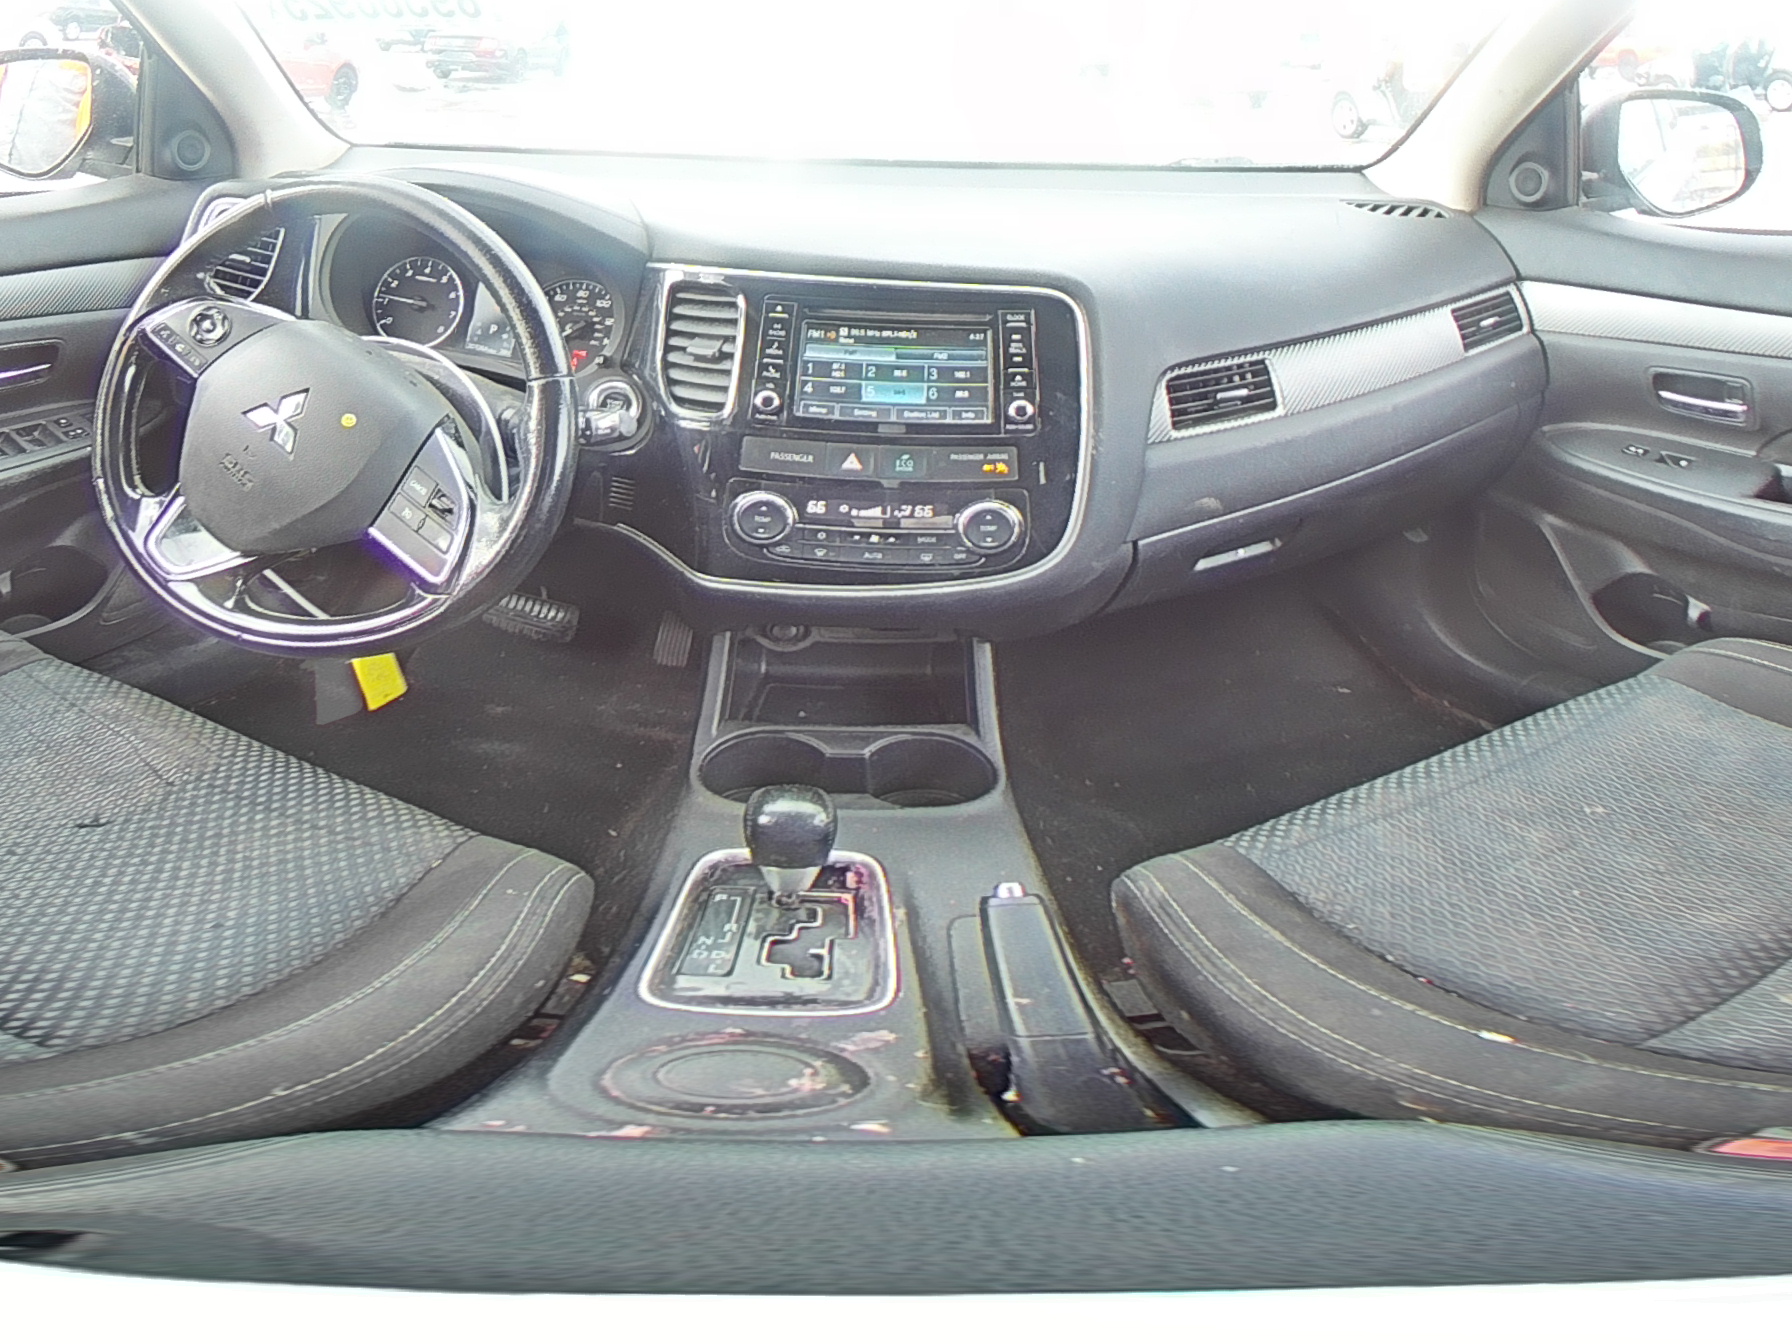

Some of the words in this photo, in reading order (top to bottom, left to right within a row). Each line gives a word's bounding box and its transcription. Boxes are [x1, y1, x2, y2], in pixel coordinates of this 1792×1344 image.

[596, 299, 612, 308] 100
[489, 323, 498, 334] P
[807, 362, 814, 374] 1
[867, 366, 876, 377] 2
[929, 368, 938, 380] 3
[803, 382, 813, 394] 4
[867, 385, 876, 397] 5
[929, 388, 938, 400] 6
[770, 452, 814, 463] PASSENGER
[895, 459, 914, 468] ECO
[807, 500, 826, 514] 66
[913, 505, 933, 518] 66
